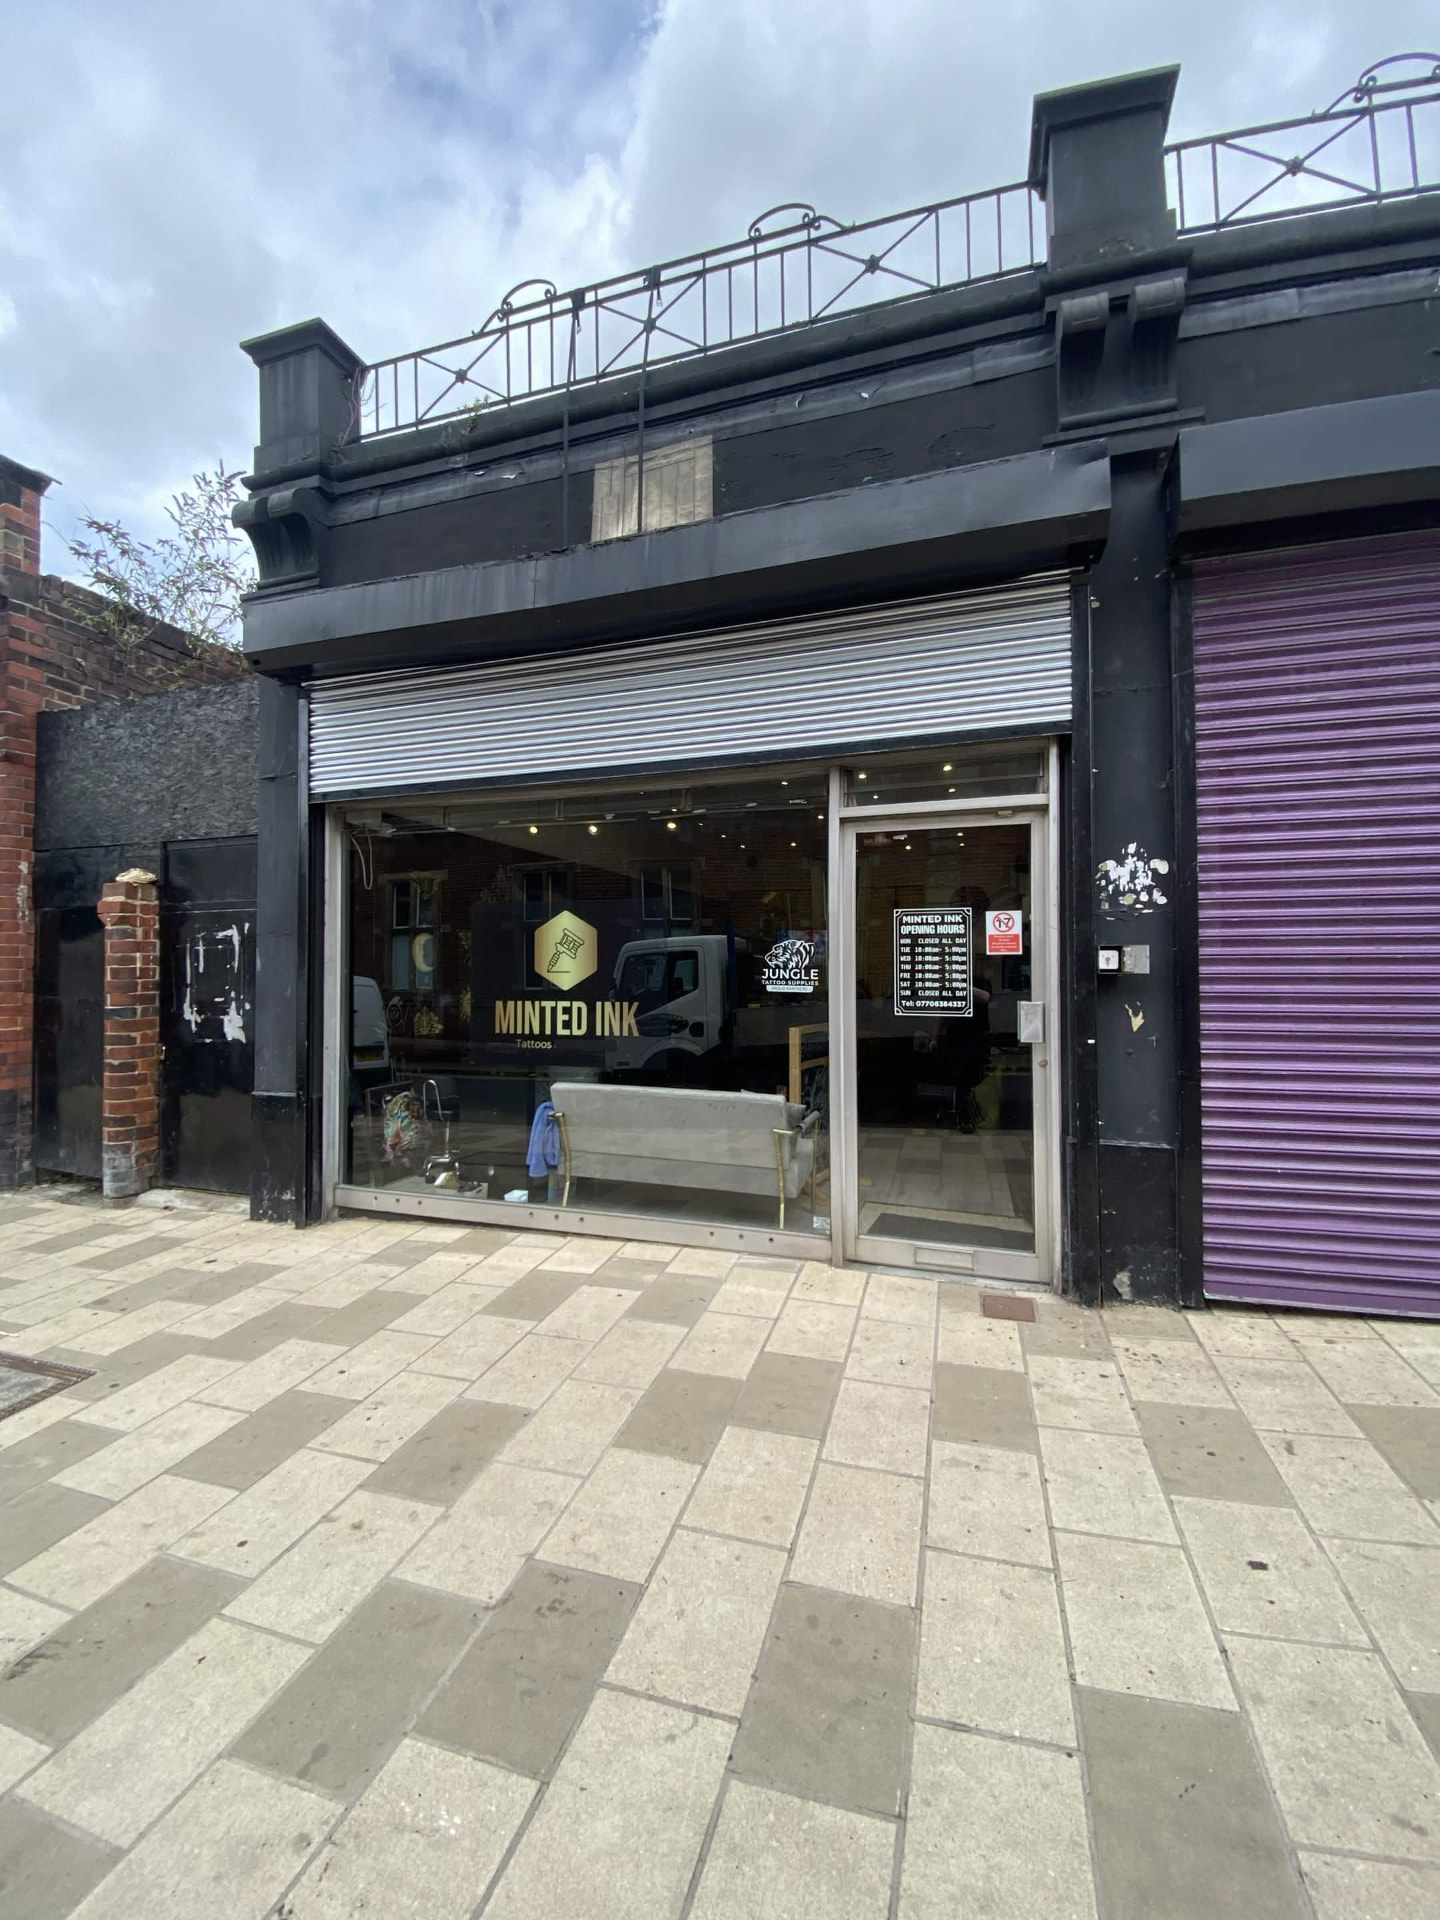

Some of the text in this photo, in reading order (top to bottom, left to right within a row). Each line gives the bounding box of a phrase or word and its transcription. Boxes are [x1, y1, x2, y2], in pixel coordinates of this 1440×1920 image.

[902, 914, 963, 924] MINTED INK
[900, 924, 965, 935] OPENING HOURS
[761, 968, 819, 980] JUNGLE
[495, 1000, 640, 1037] MINTED INK
[516, 1039, 553, 1049] Tattoos
